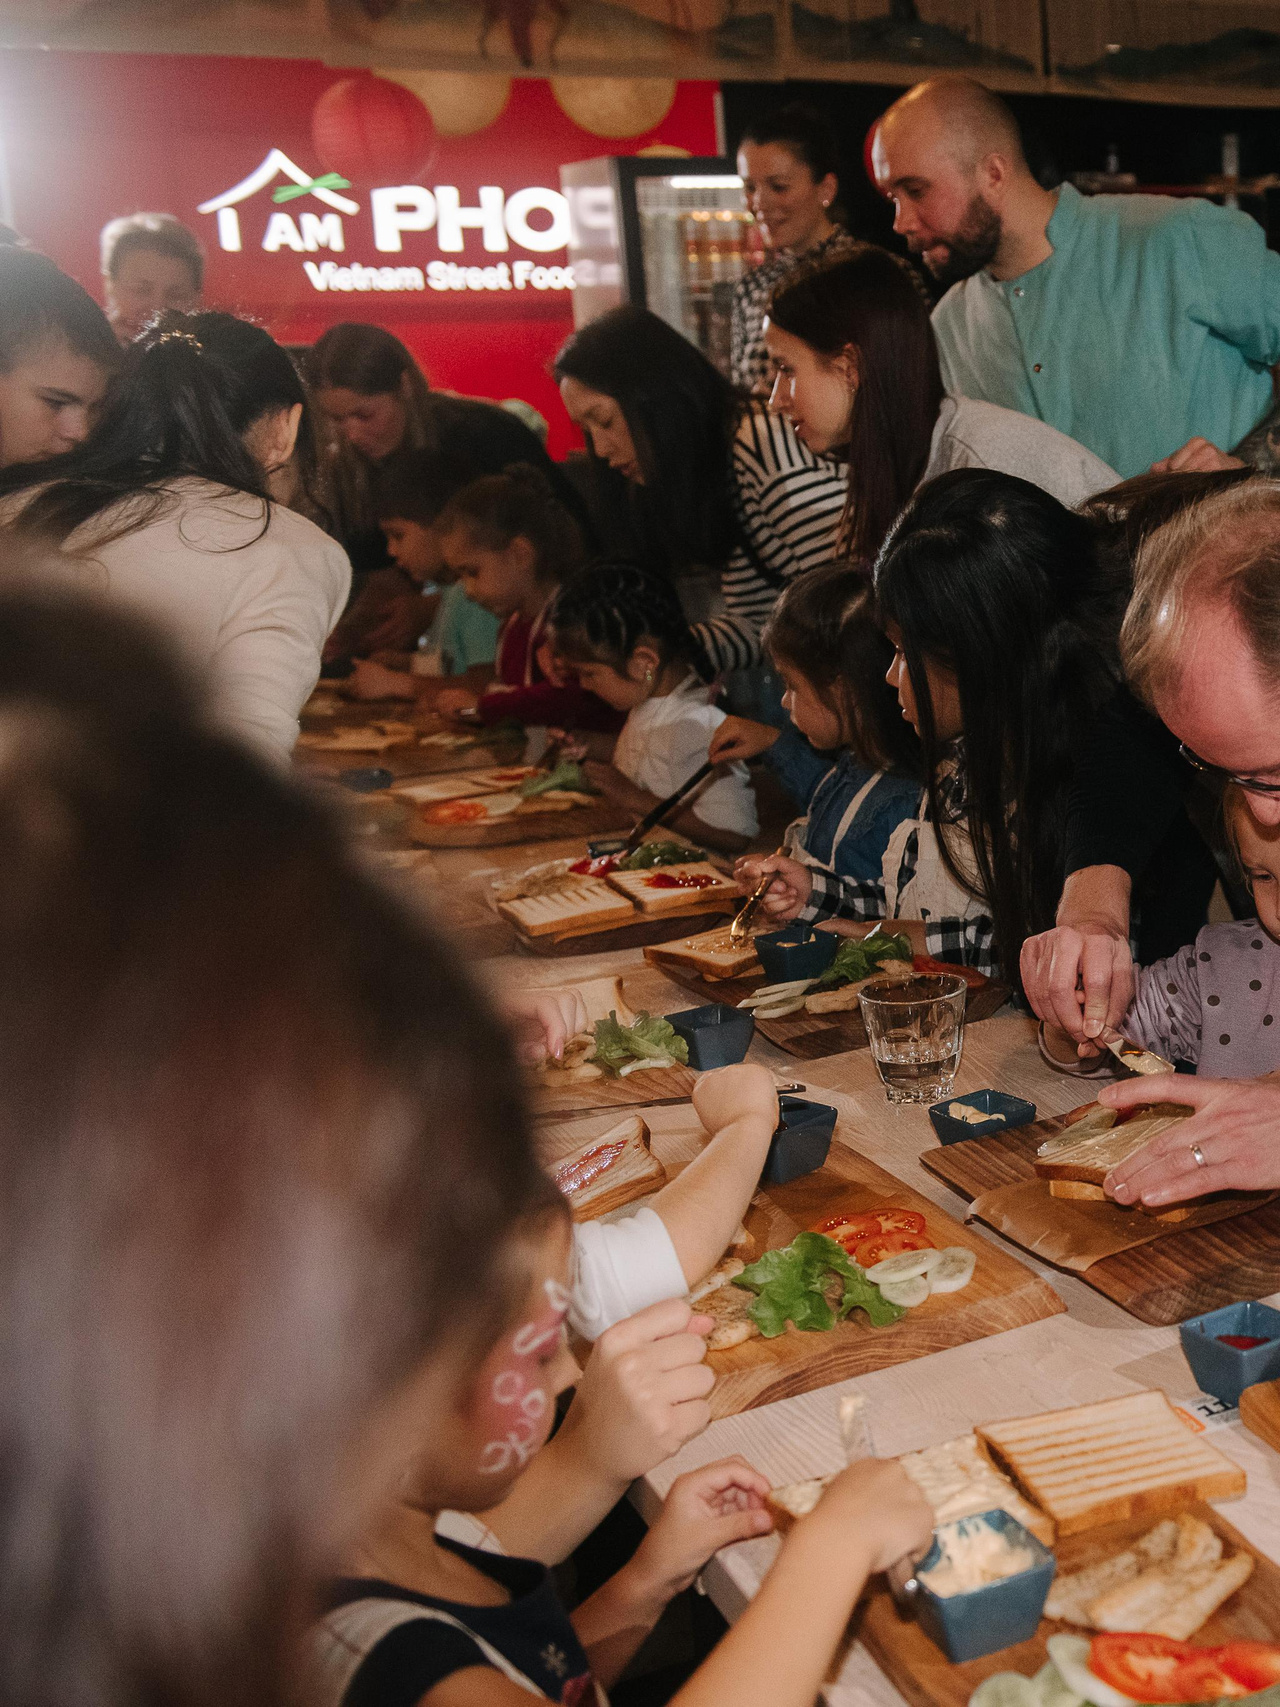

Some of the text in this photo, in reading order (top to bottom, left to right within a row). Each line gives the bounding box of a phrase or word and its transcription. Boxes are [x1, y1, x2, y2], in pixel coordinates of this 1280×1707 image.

[217, 206, 242, 252] I
[261, 213, 345, 252] AM
[370, 185, 572, 252] PHO
[303, 260, 425, 291] Vietnam
[426, 260, 512, 291] Street
